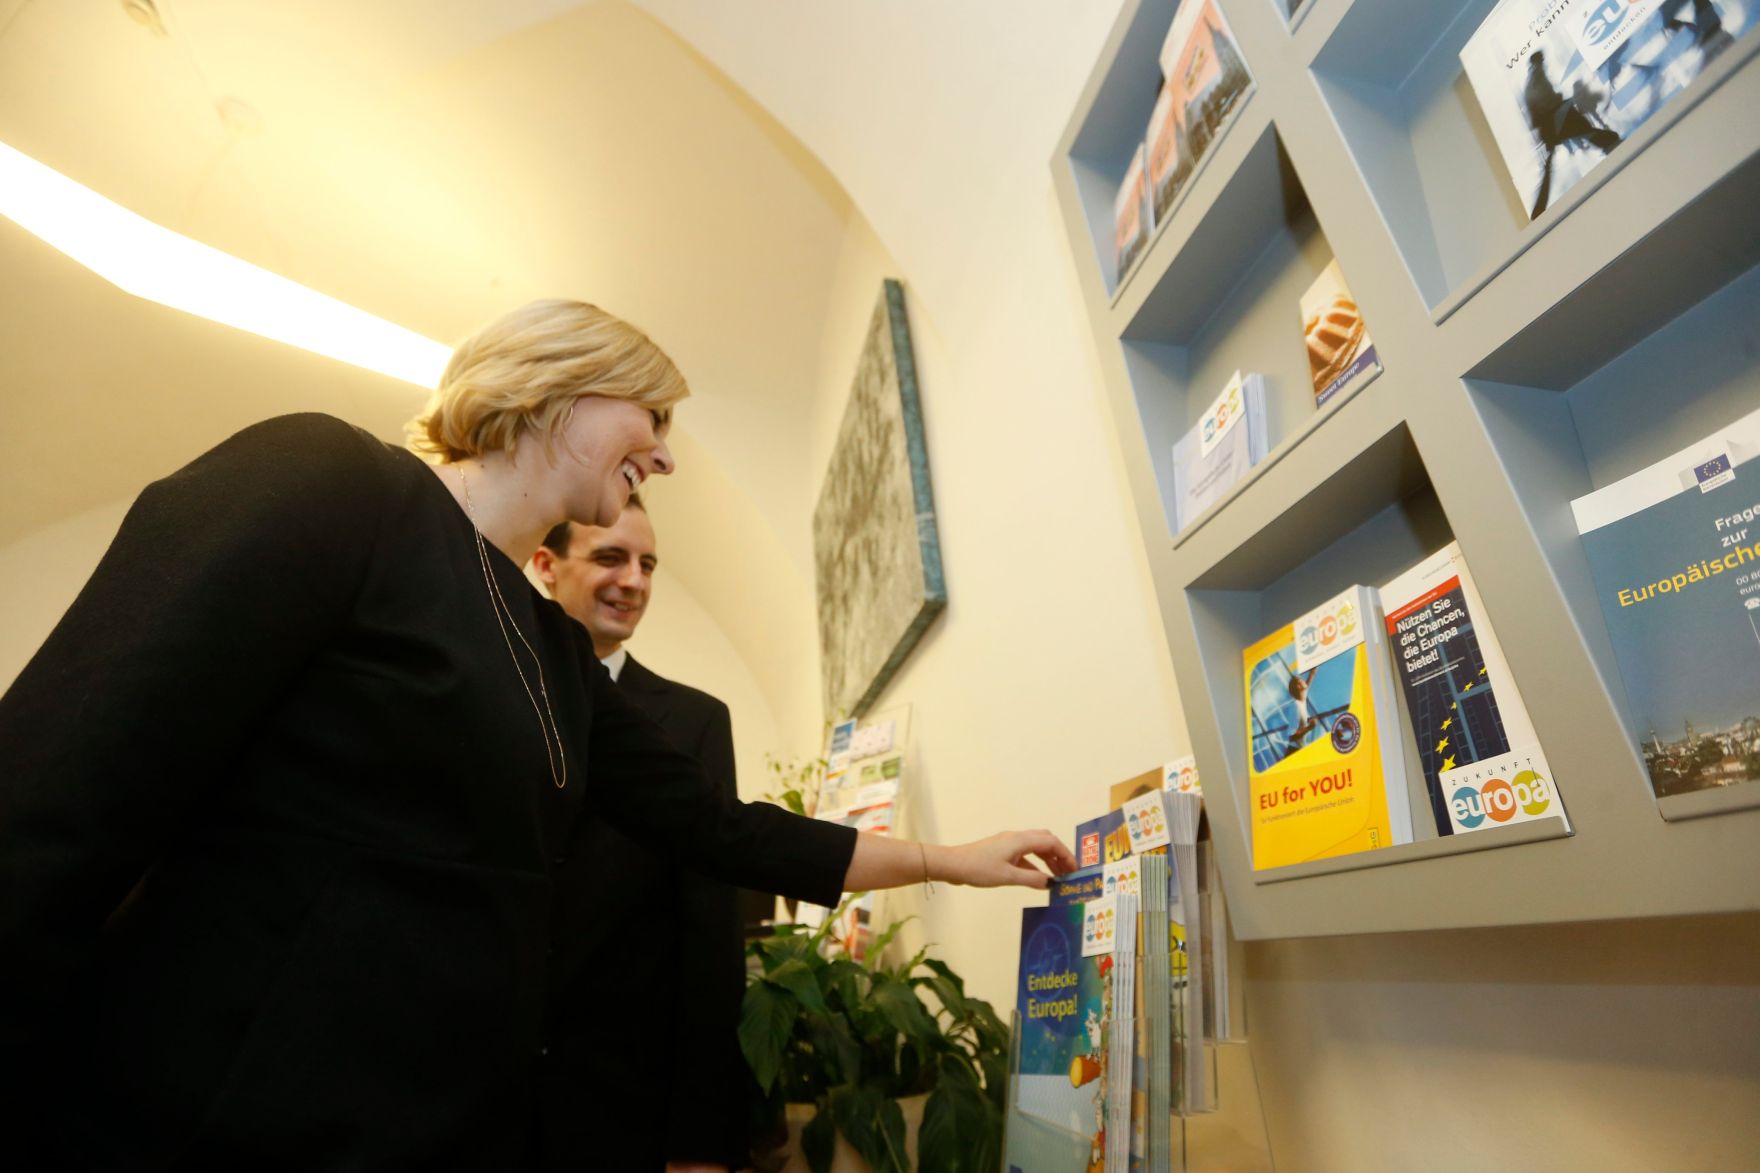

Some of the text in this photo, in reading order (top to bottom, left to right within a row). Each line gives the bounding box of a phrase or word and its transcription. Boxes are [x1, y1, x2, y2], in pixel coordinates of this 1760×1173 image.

[1506, 40, 1531, 69] Wer
[1721, 528, 1748, 547] zur
[1396, 608, 1432, 633] Nützen
[1433, 598, 1451, 614] Sie
[1400, 608, 1465, 646] die Chancen,
[1403, 626, 1458, 659] die Europa
[1406, 649, 1439, 673] bietet!
[1260, 768, 1353, 810] EU for YOU!
[1452, 777, 1550, 822] europa
[1028, 969, 1077, 991] Entdecke
[1028, 993, 1077, 1022] Europa!
